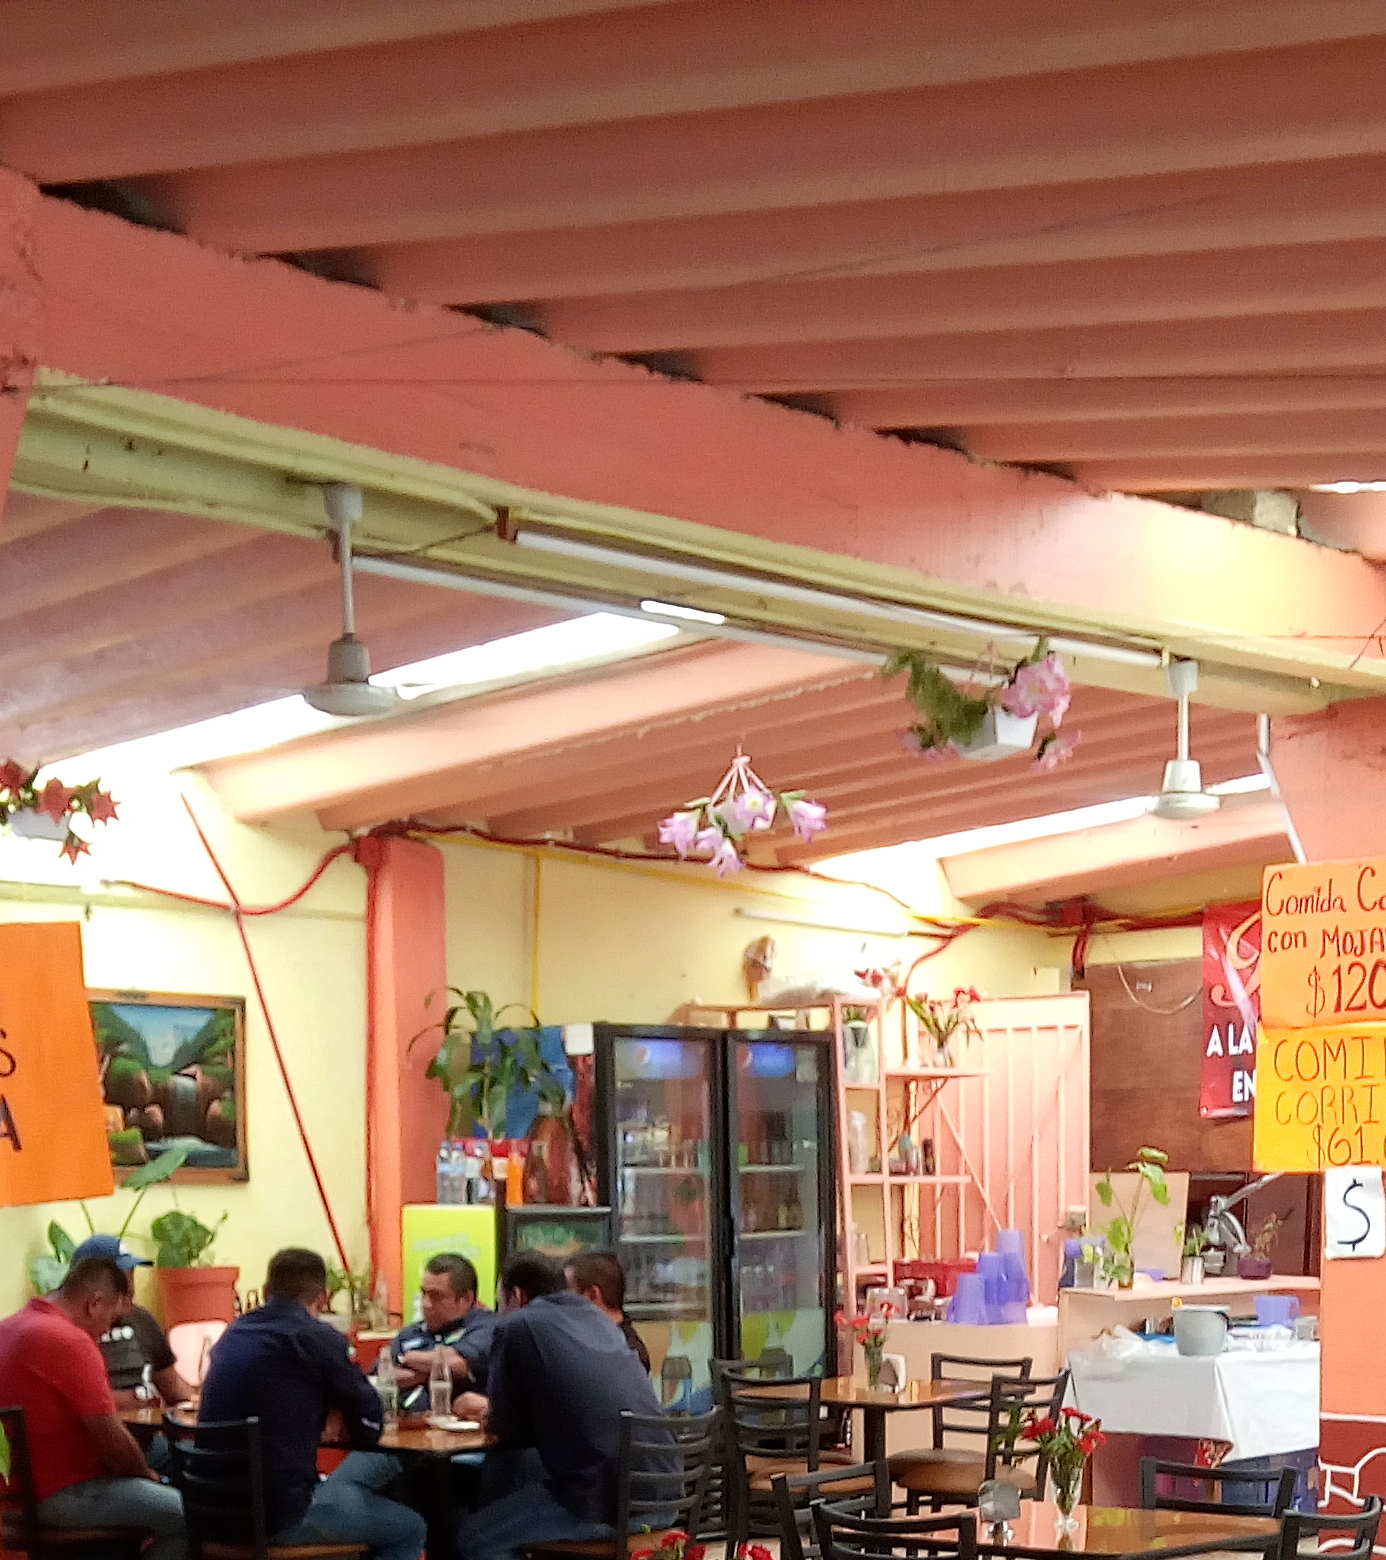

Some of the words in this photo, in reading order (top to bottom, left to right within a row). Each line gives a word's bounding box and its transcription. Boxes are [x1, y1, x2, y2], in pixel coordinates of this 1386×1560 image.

[1265, 871, 1348, 917] Comida
[1266, 929, 1308, 954] con
[1206, 1022, 1224, 1058] A
[1227, 1022, 1254, 1056] LA
